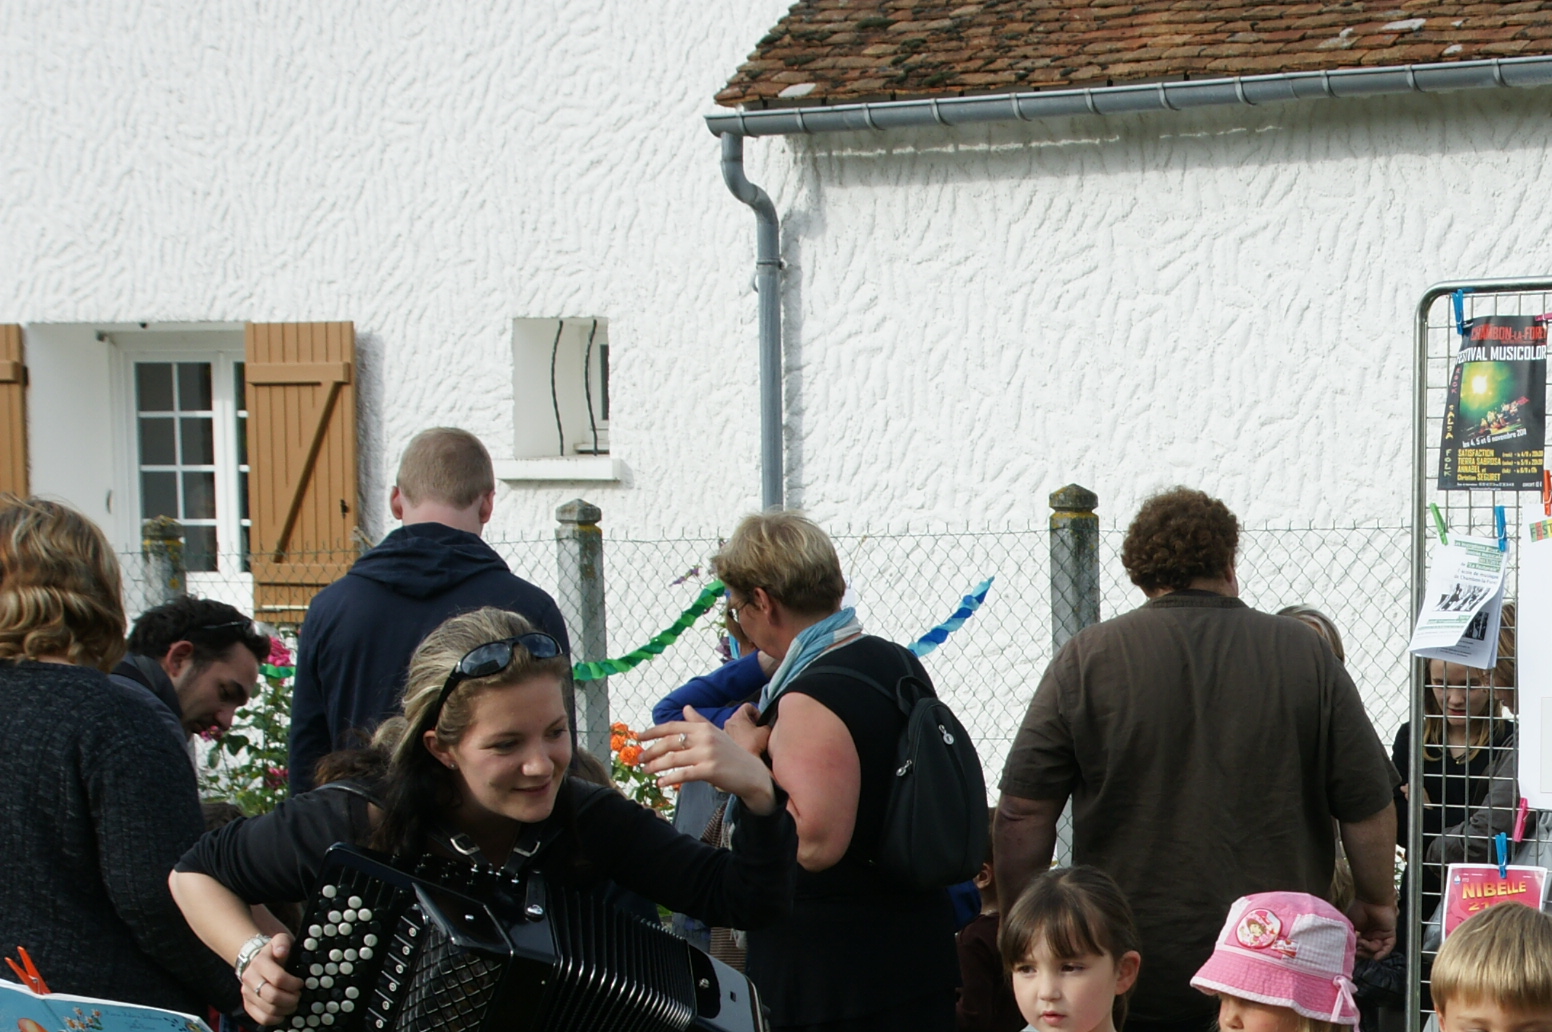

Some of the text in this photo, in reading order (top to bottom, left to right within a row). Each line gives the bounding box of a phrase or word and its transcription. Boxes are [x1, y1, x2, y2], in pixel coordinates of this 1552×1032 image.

[1456, 345, 1547, 365] FESTIVAL MUSICOLOR
[1445, 405, 1455, 440] SALSA
[1462, 440, 1471, 448] les
[1491, 431, 1517, 443] novembre
[1458, 449, 1495, 457] SATISFACTION
[1443, 449, 1453, 477] FOLK
[1462, 881, 1526, 899] NIBELLE
